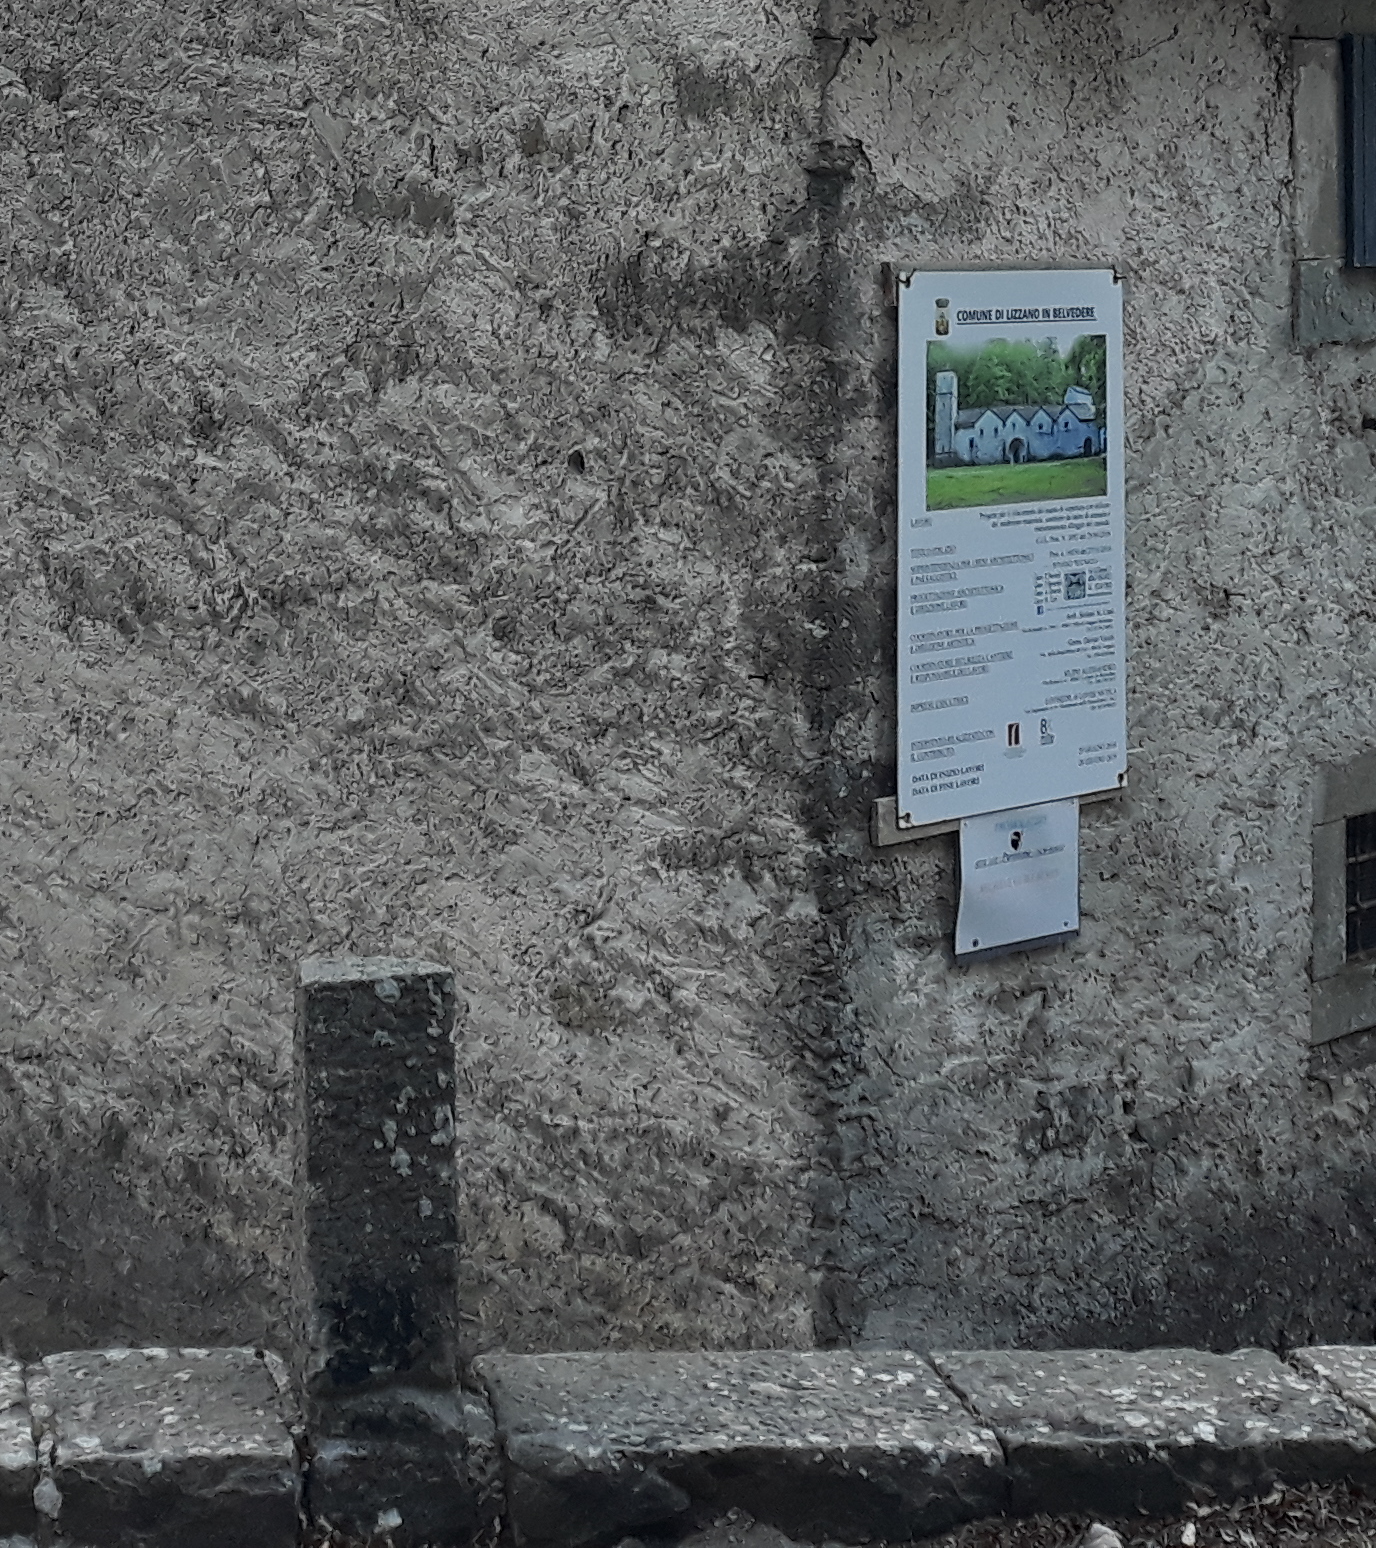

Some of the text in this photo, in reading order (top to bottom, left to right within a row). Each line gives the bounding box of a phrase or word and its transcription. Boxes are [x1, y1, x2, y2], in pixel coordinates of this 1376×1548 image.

[956, 306, 1096, 322] COMUNE DI LIZZANO IN BELVEDERE
